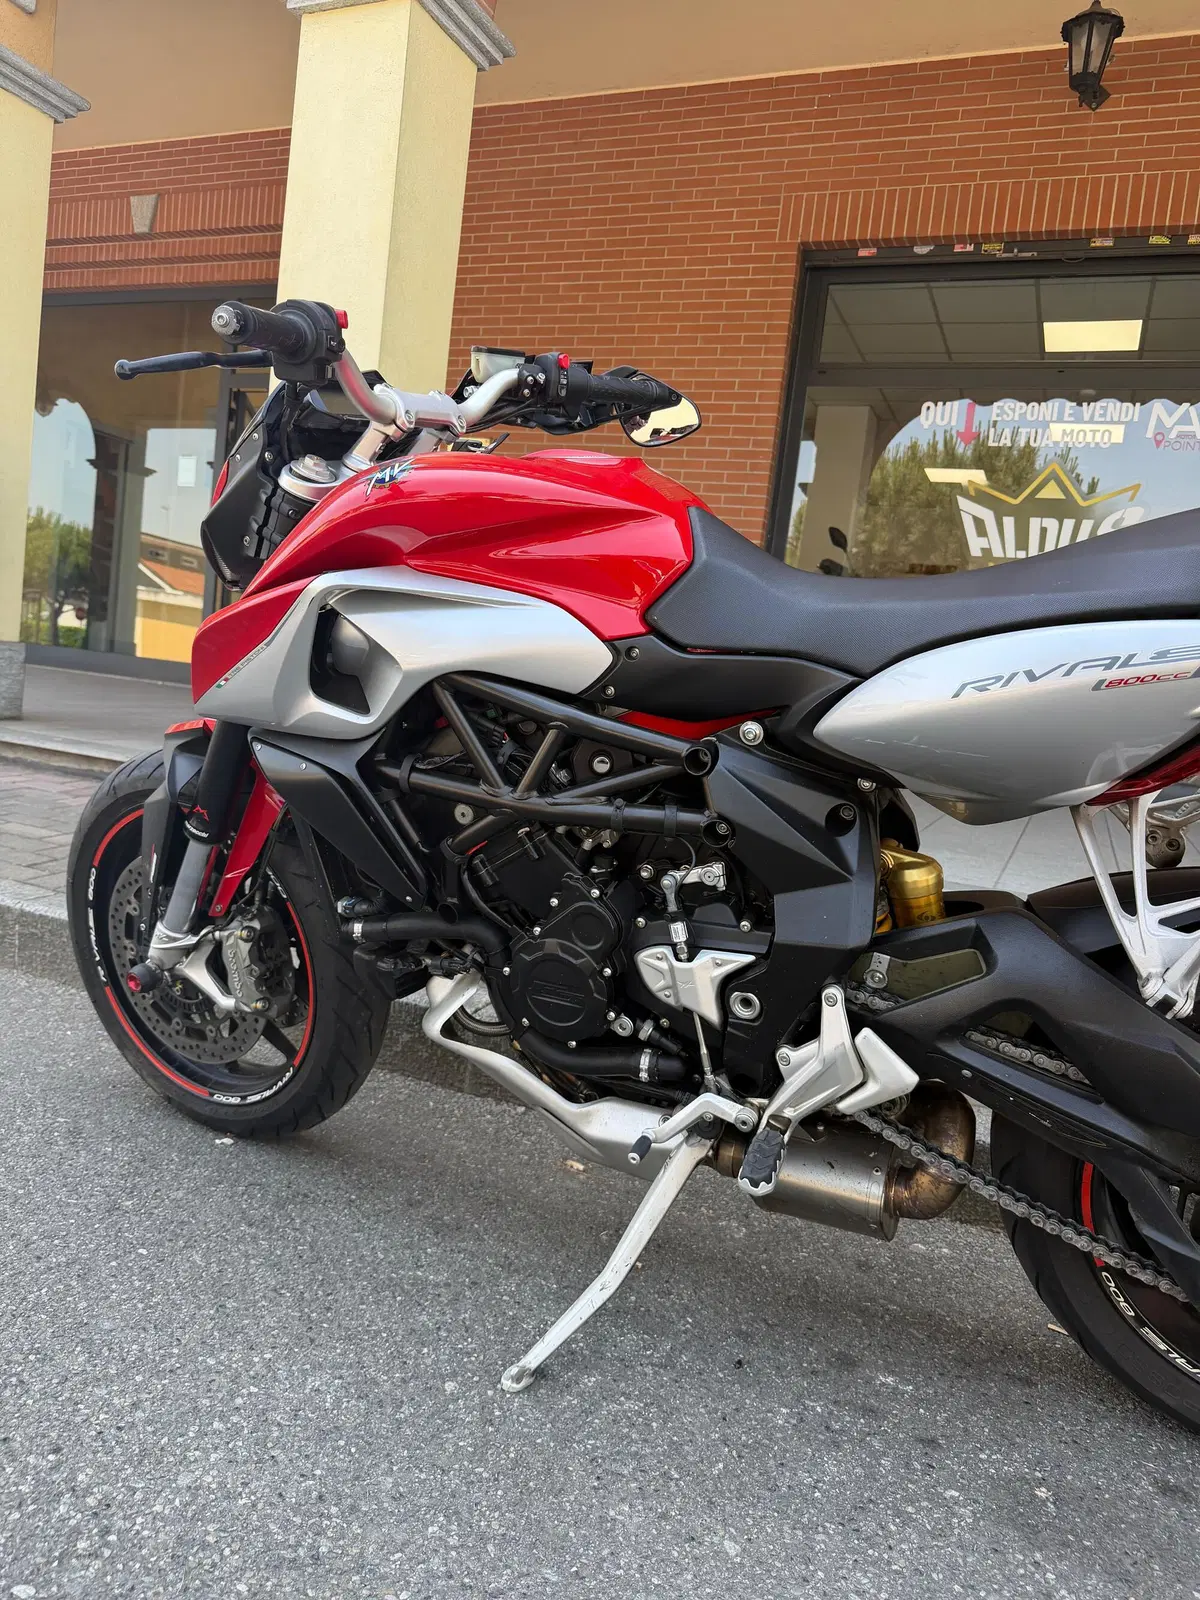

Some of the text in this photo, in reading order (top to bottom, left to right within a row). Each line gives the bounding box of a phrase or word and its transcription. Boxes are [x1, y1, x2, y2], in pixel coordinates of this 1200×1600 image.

[920, 401, 959, 429] QUI
[992, 402, 1141, 422] ESPONI E VENDI
[988, 427, 1112, 448] LA TUA MOTO
[1105, 672, 1191, 688] 800cc
[213, 1093, 241, 1104] 800
[1101, 1271, 1135, 1316] 800
